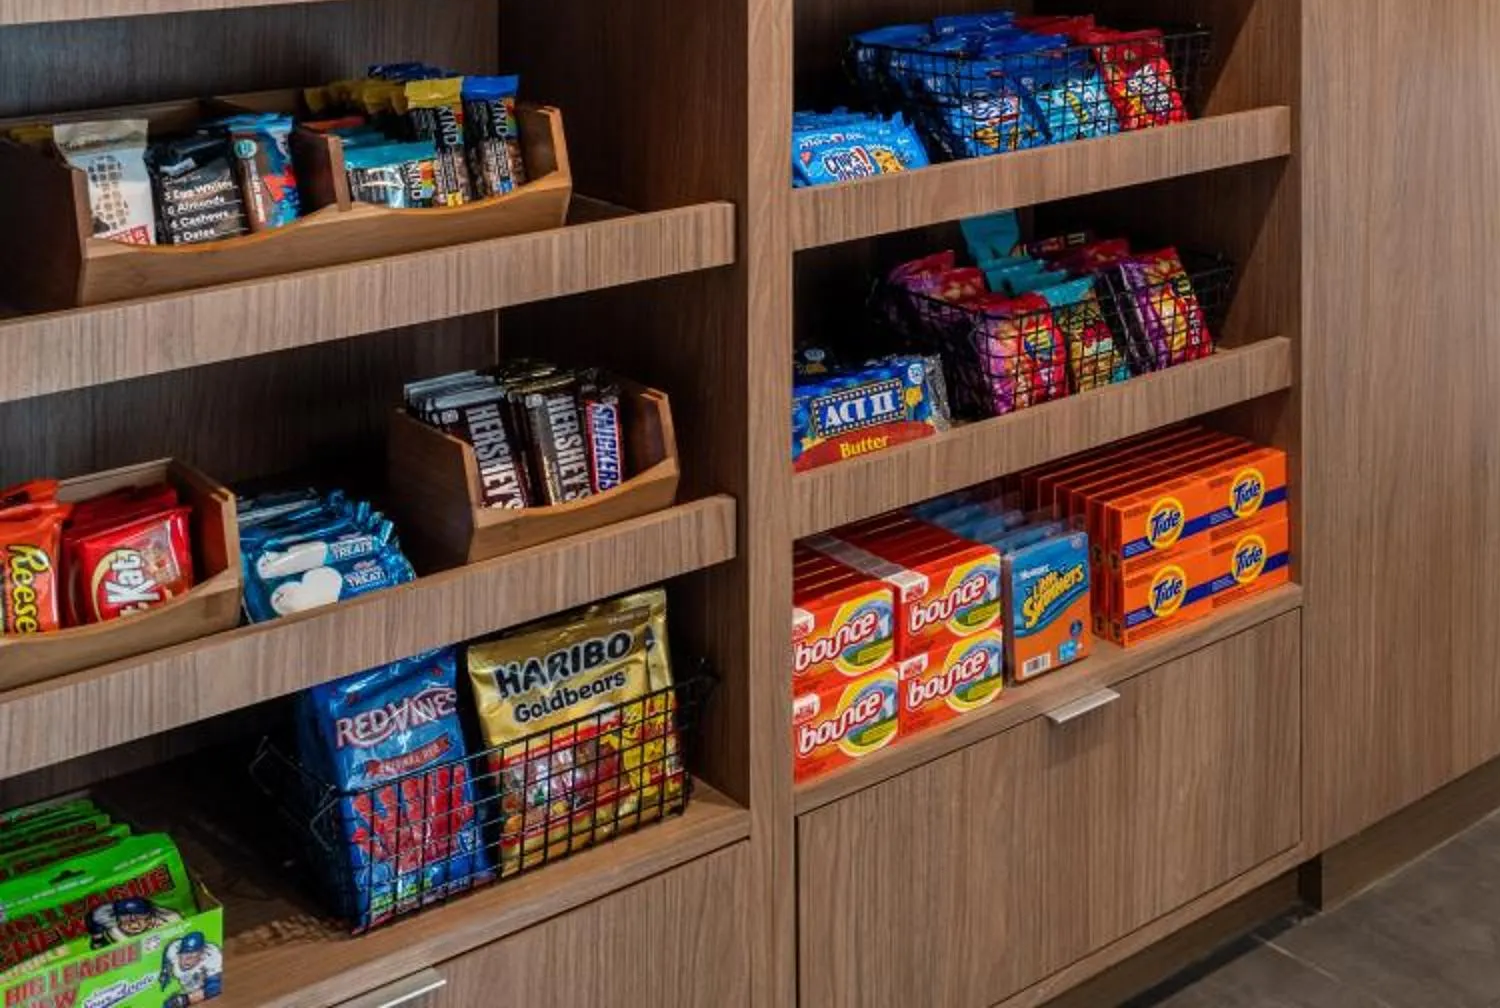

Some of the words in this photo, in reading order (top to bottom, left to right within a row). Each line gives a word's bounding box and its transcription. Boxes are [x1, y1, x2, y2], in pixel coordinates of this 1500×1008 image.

[177, 195, 225, 211] Almonds
[183, 228, 216, 241] Dates
[824, 396, 866, 429] ACT
[870, 389, 896, 418] II
[466, 403, 525, 509] HERSHEY'S
[547, 393, 593, 503] HERSHEY'S
[839, 434, 889, 459] Butter
[1234, 479, 1261, 510] Tide
[1151, 510, 1181, 542] Tide
[1236, 545, 1263, 577] Tide
[7, 544, 49, 633] Reese
[911, 573, 987, 633] bounce
[1153, 578, 1183, 613] Tide
[794, 611, 879, 672] bounce
[494, 632, 634, 700] HARIBO
[908, 649, 988, 708] bounce
[514, 668, 627, 724] Goldbears
[336, 708, 389, 749] RED
[800, 689, 884, 755] bounce
